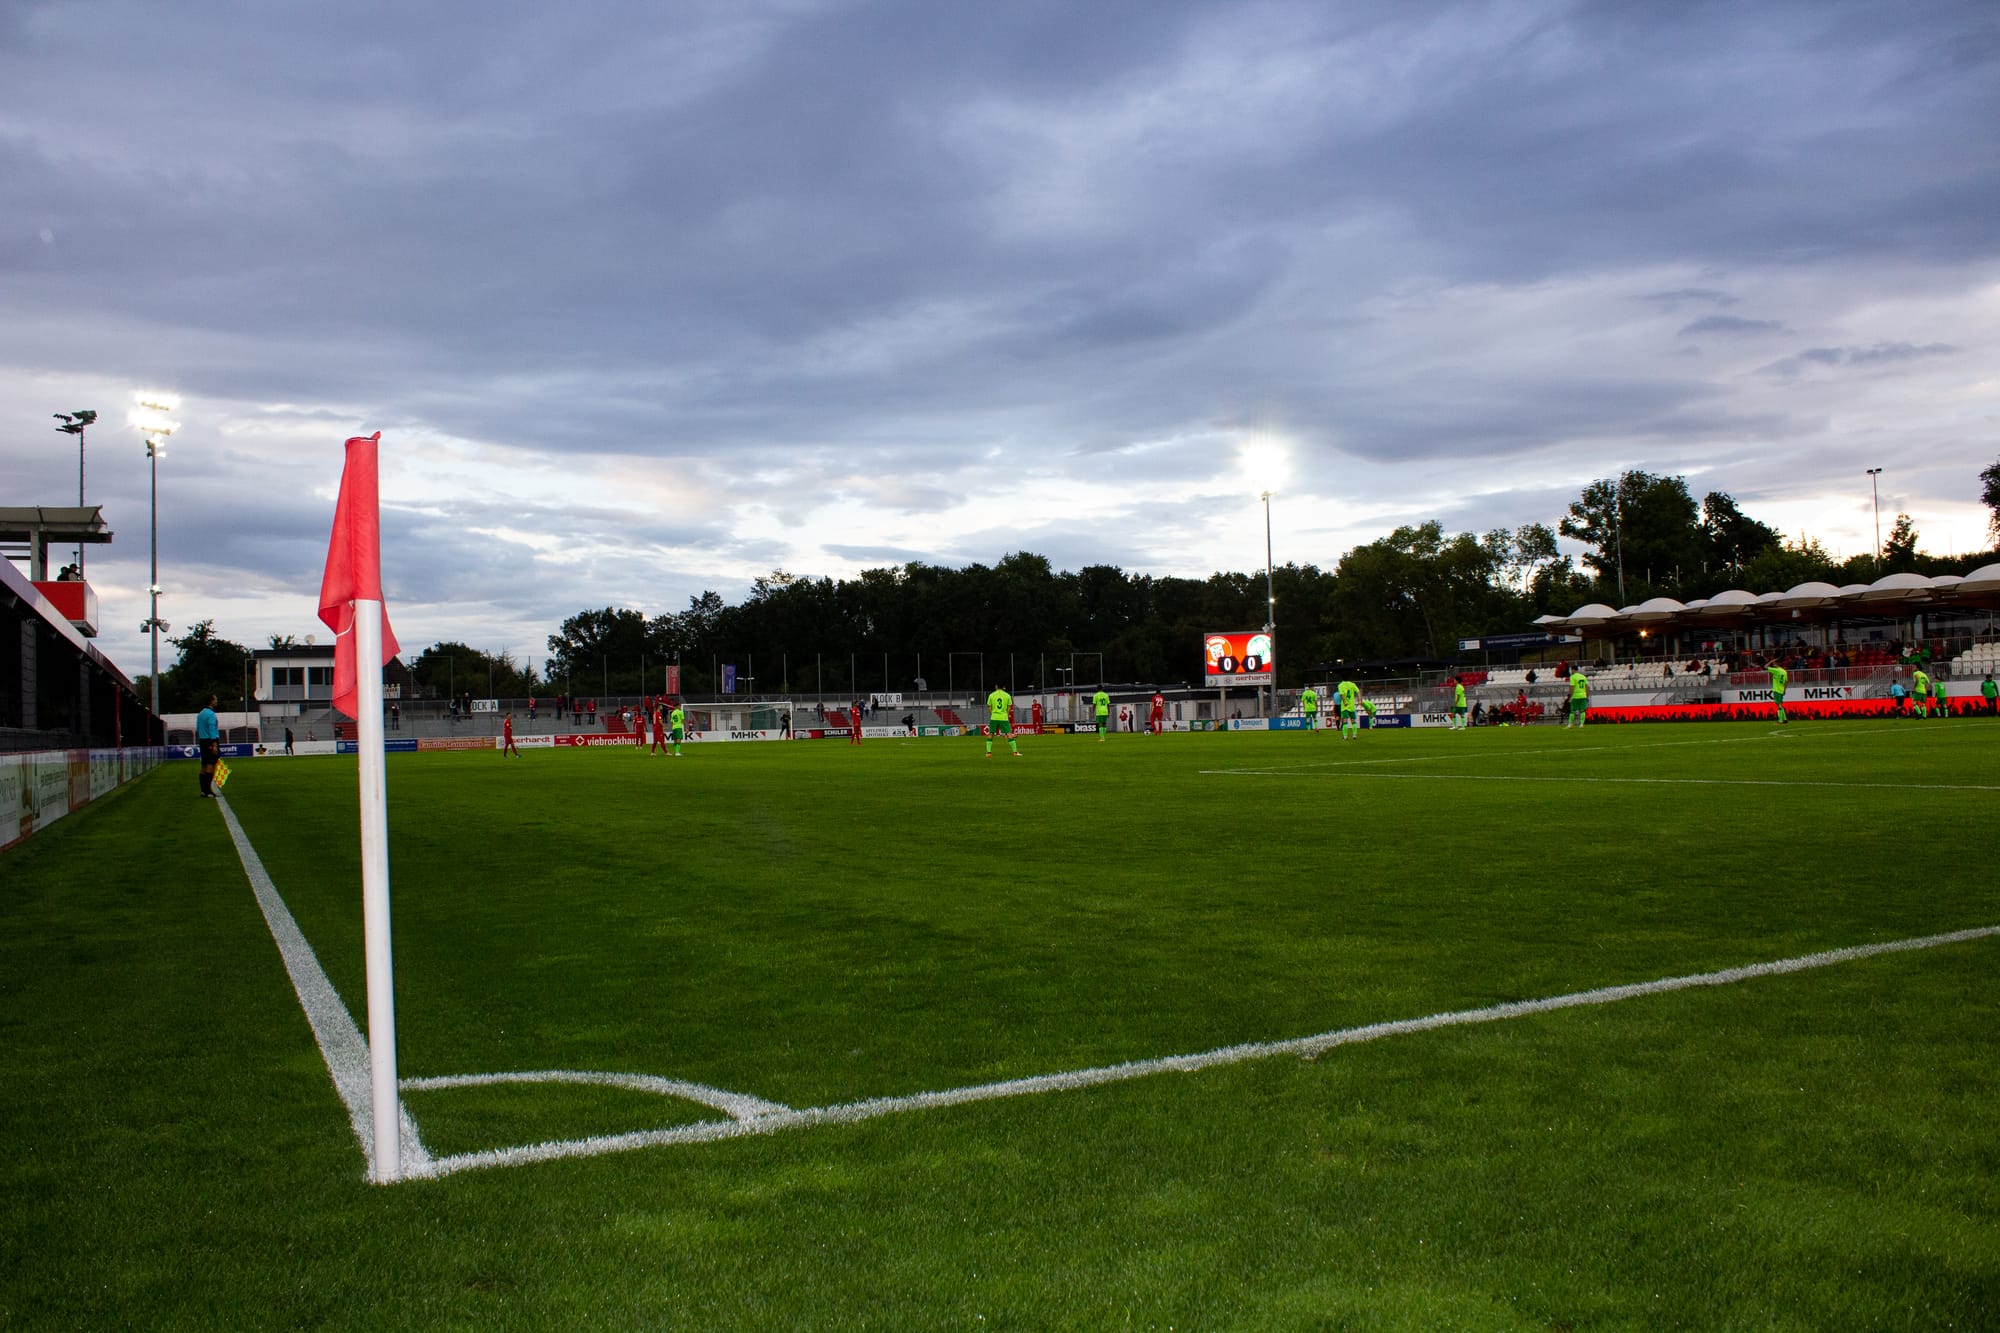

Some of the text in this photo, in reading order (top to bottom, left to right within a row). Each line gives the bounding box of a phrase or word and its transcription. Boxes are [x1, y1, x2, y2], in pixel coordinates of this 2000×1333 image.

[1223, 656, 1256, 671] 0 0
[1739, 691, 1774, 701] MHK
[1804, 688, 1842, 698] MHK
[491, 701, 498, 711] A
[997, 698, 1003, 709] 3
[1155, 698, 1164, 707] 23
[1287, 719, 1301, 727] JAKO
[1423, 714, 1447, 723] MHK
[1074, 723, 1097, 732] brass
[663, 733, 694, 741] MK
[731, 732, 758, 740] MHK
